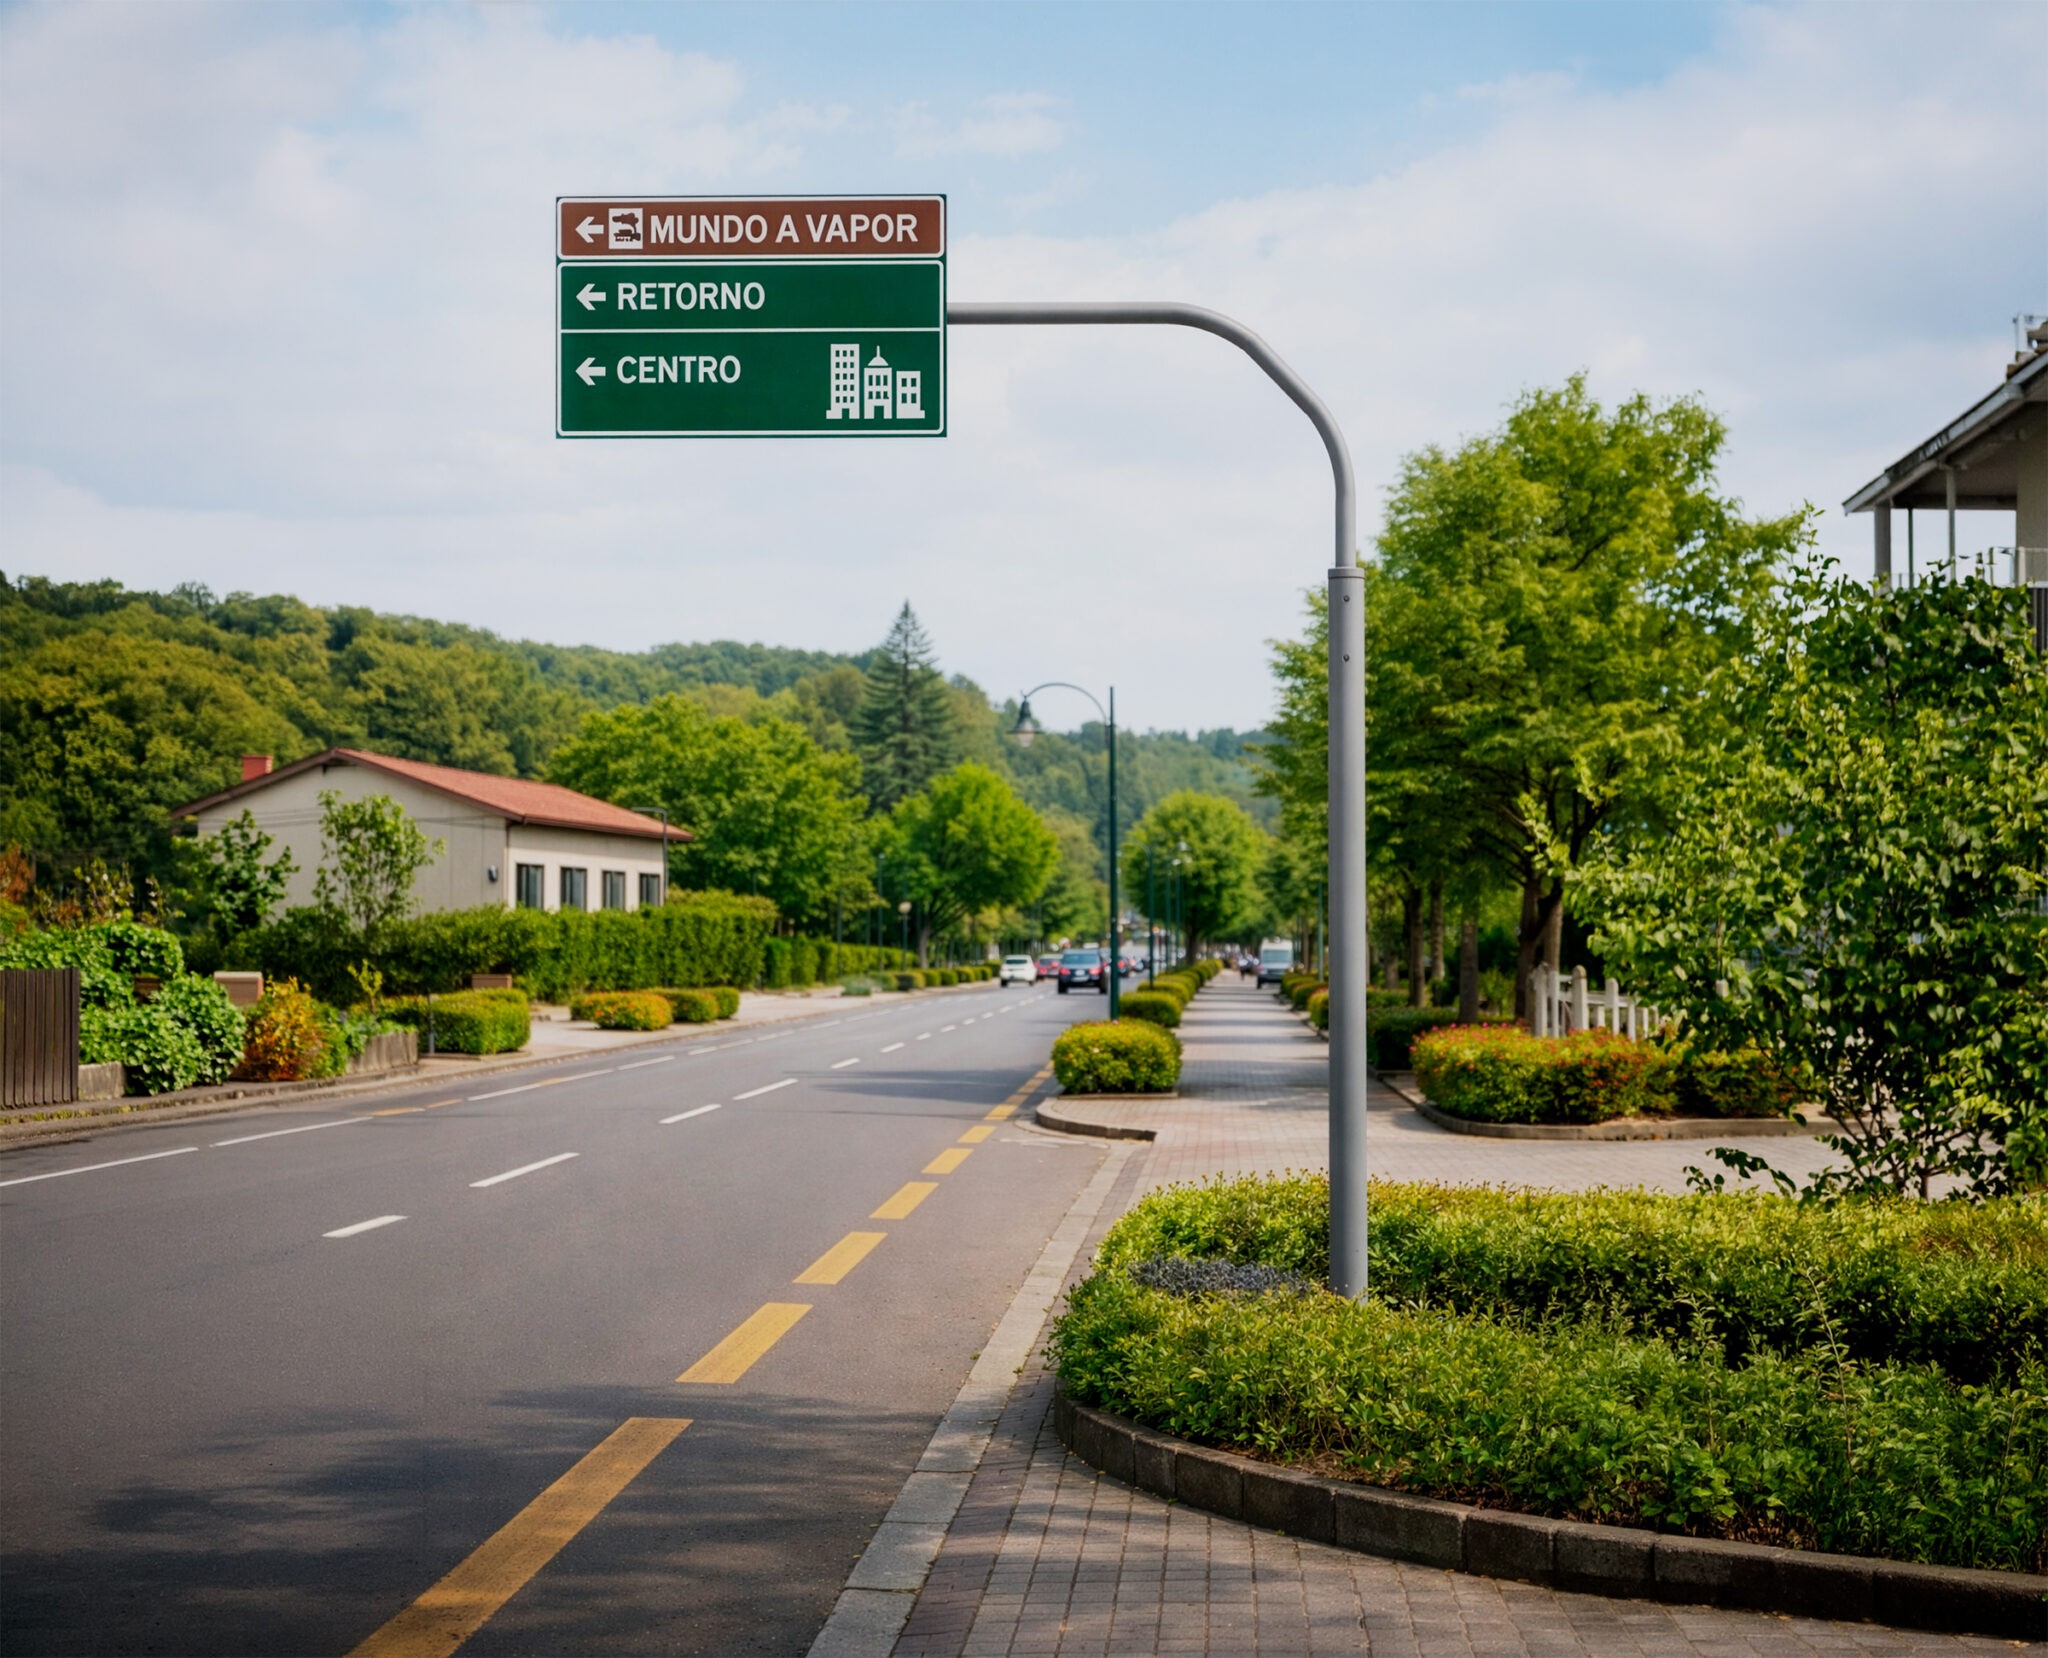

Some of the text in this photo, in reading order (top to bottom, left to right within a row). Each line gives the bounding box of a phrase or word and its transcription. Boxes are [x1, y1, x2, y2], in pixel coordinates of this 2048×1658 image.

[650, 213, 919, 244] MUNDO A VAPOR
[617, 282, 766, 310] RETORNO
[616, 355, 741, 384] CENTRO
